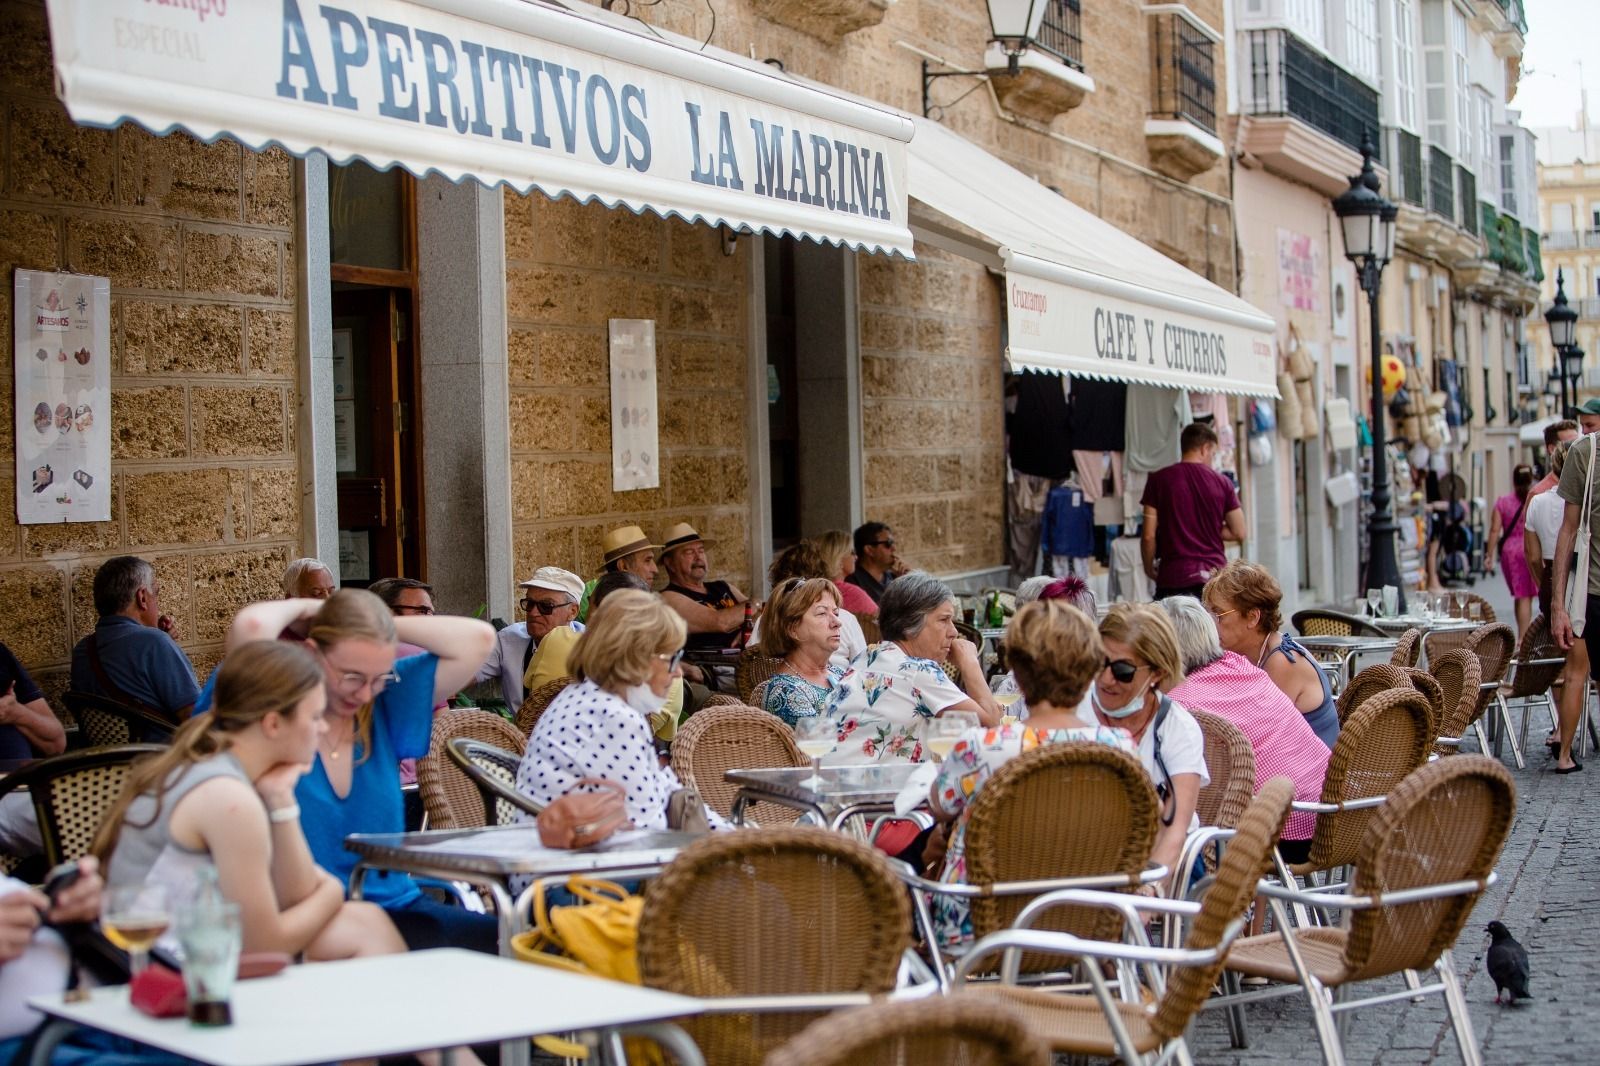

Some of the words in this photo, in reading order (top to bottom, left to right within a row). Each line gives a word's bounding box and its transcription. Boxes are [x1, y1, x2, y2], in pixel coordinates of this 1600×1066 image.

[113, 17, 206, 62] ESPECIAL
[276, 0, 652, 173] APERITIVOS
[686, 102, 744, 191] LA
[750, 118, 891, 221] MARINA
[1012, 282, 1047, 317] Cruzcampo
[1094, 307, 1137, 362] CAFE
[1144, 319, 1155, 365] Y
[1163, 322, 1227, 376] CHURROS
